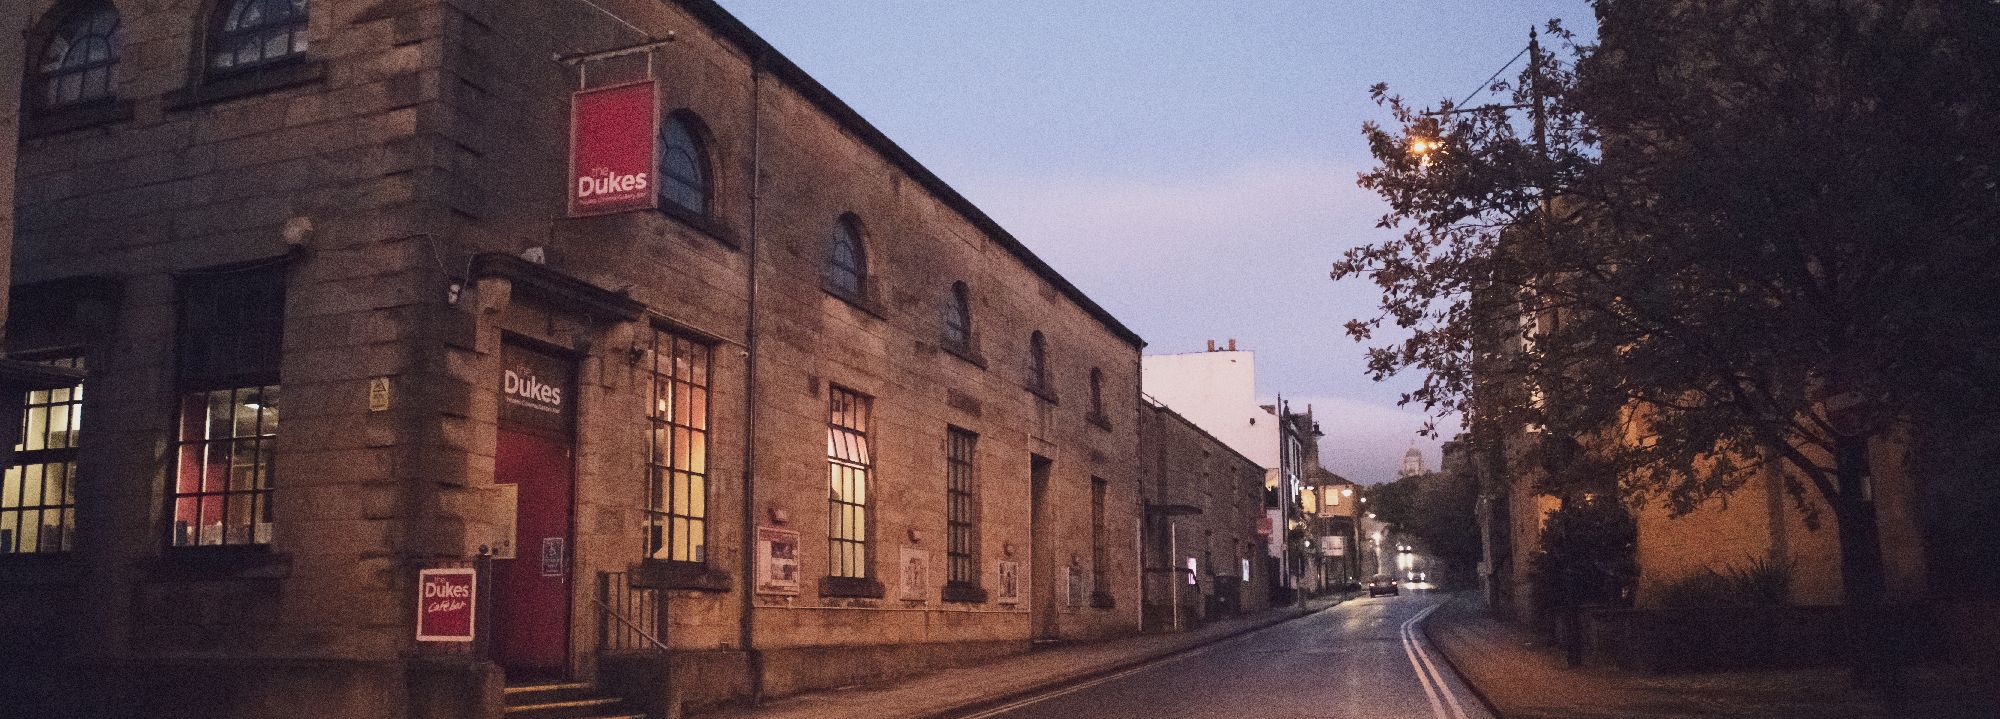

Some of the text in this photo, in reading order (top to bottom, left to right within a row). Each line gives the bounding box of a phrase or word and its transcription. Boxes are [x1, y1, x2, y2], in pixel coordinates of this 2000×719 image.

[578, 171, 648, 198] Dukes
[504, 369, 561, 406] Dukes
[425, 581, 470, 598] Dukes
